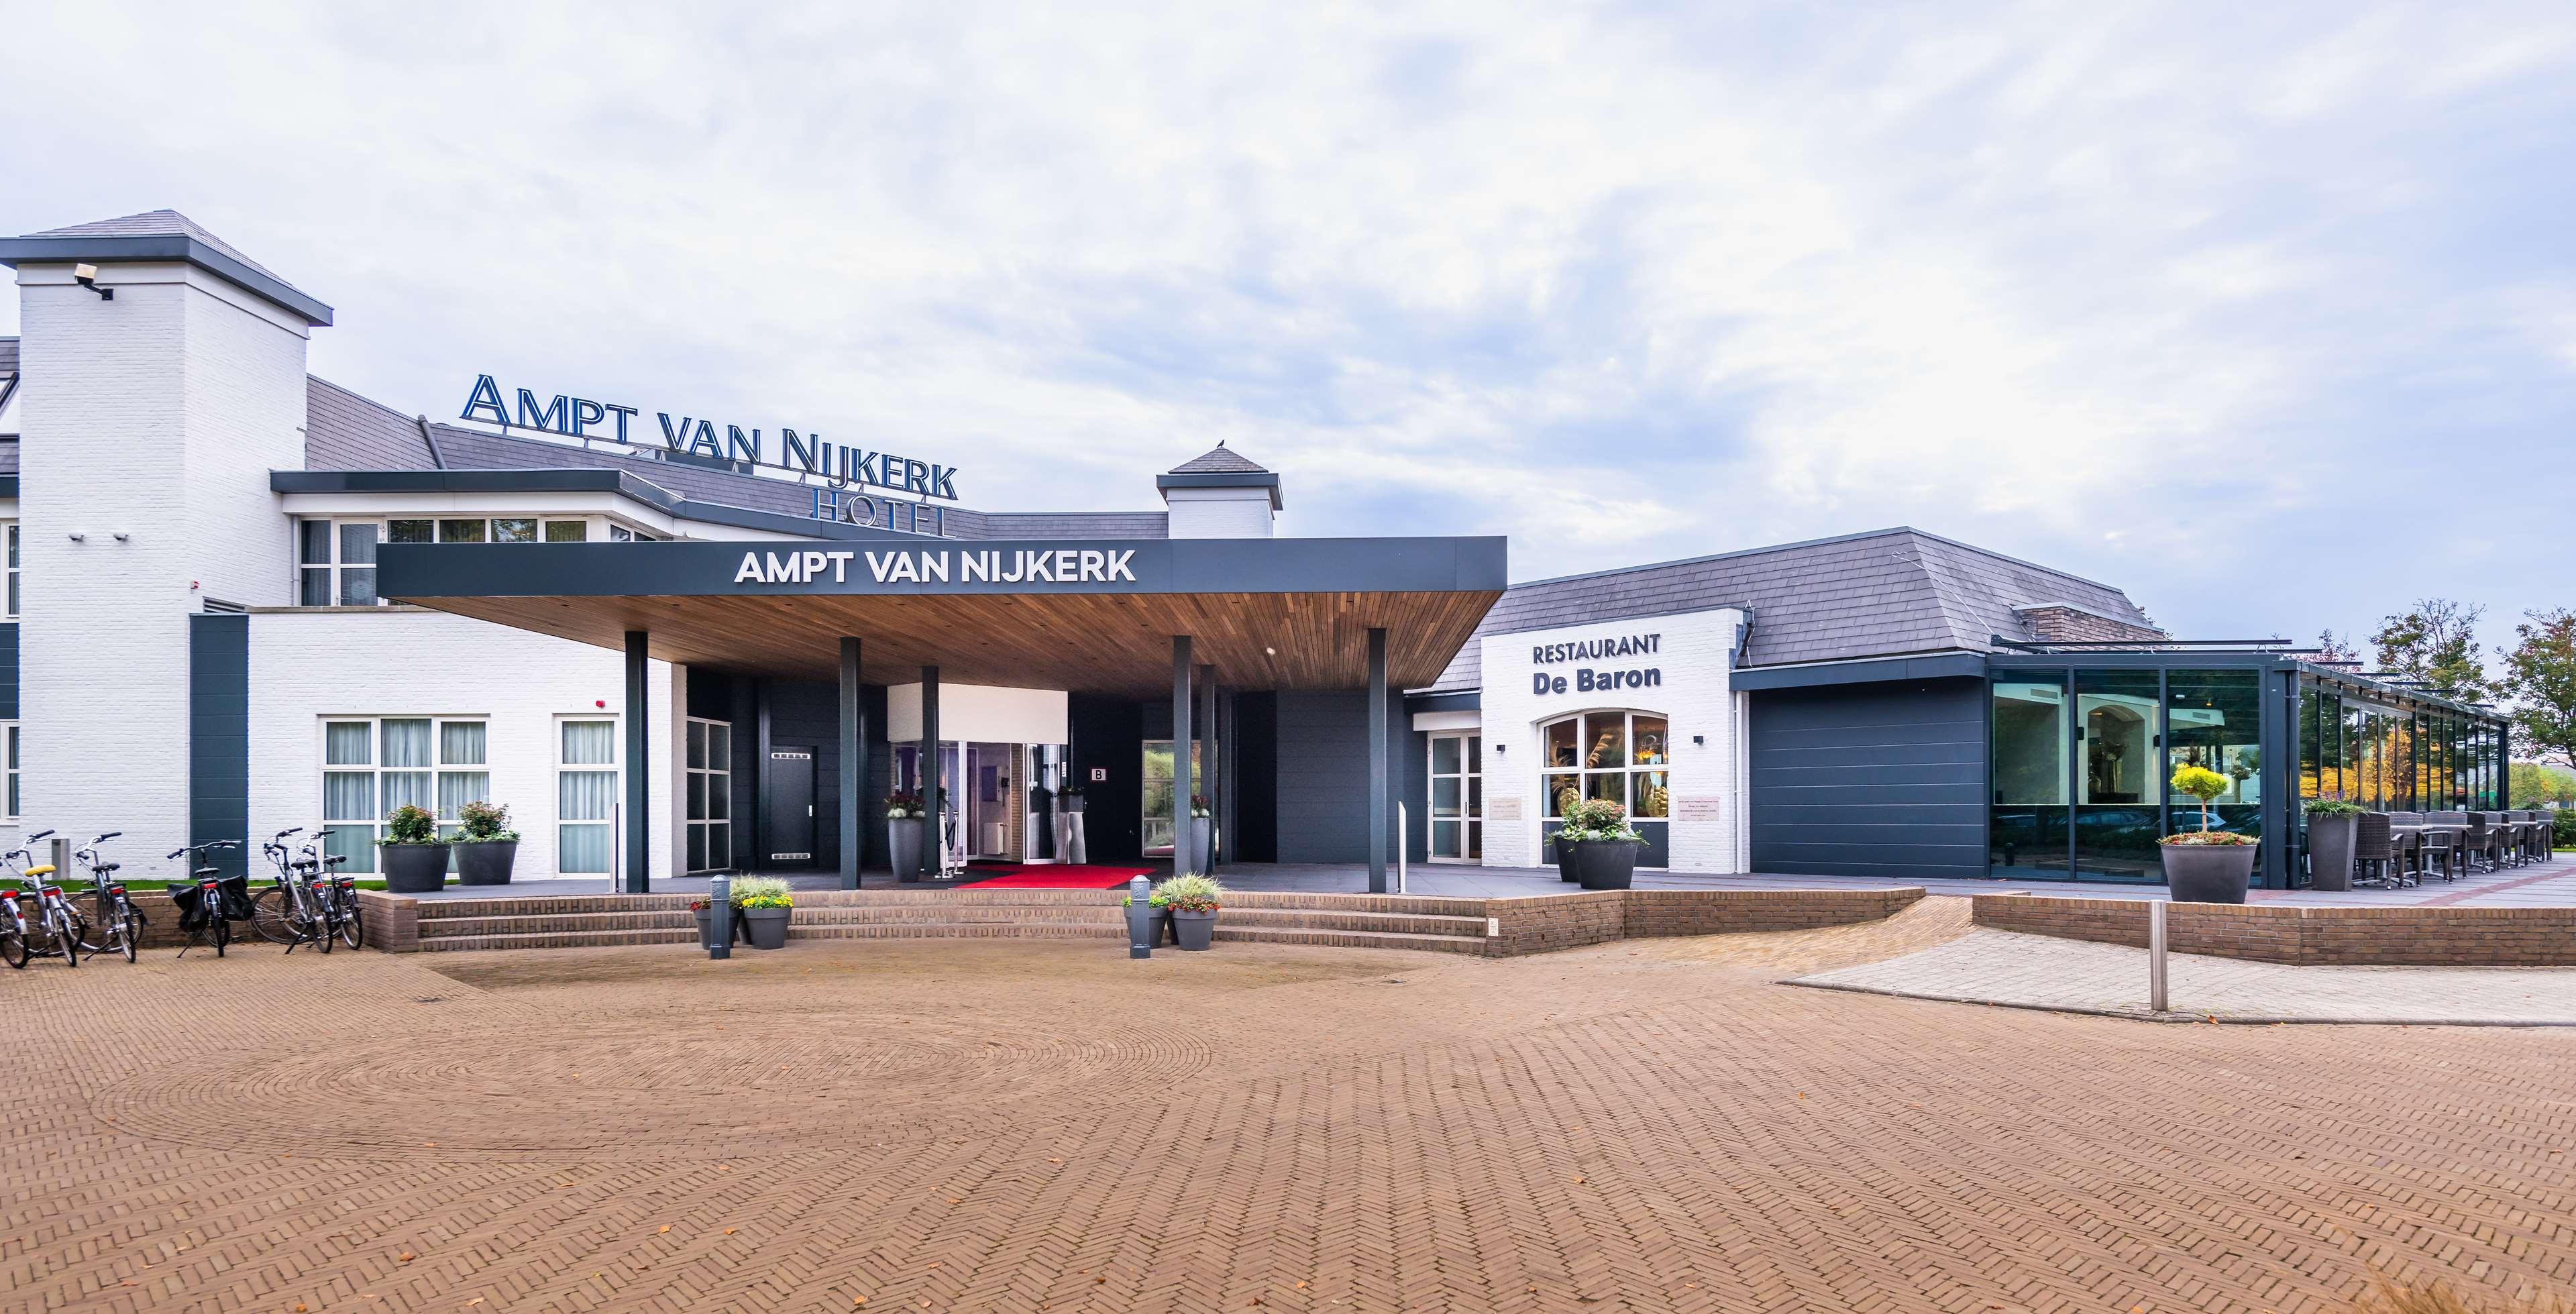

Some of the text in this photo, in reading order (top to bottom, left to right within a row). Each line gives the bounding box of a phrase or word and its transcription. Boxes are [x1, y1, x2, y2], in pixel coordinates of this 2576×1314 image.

[459, 374, 959, 500] AMPT VAN NIJKERK
[812, 488, 959, 538] HOTEL
[733, 549, 1136, 583] AMPT VAN NIJKERK
[1533, 633, 1661, 664] RESTAURANT
[1533, 667, 1661, 695] De Baron
[1095, 770, 1102, 779] B
